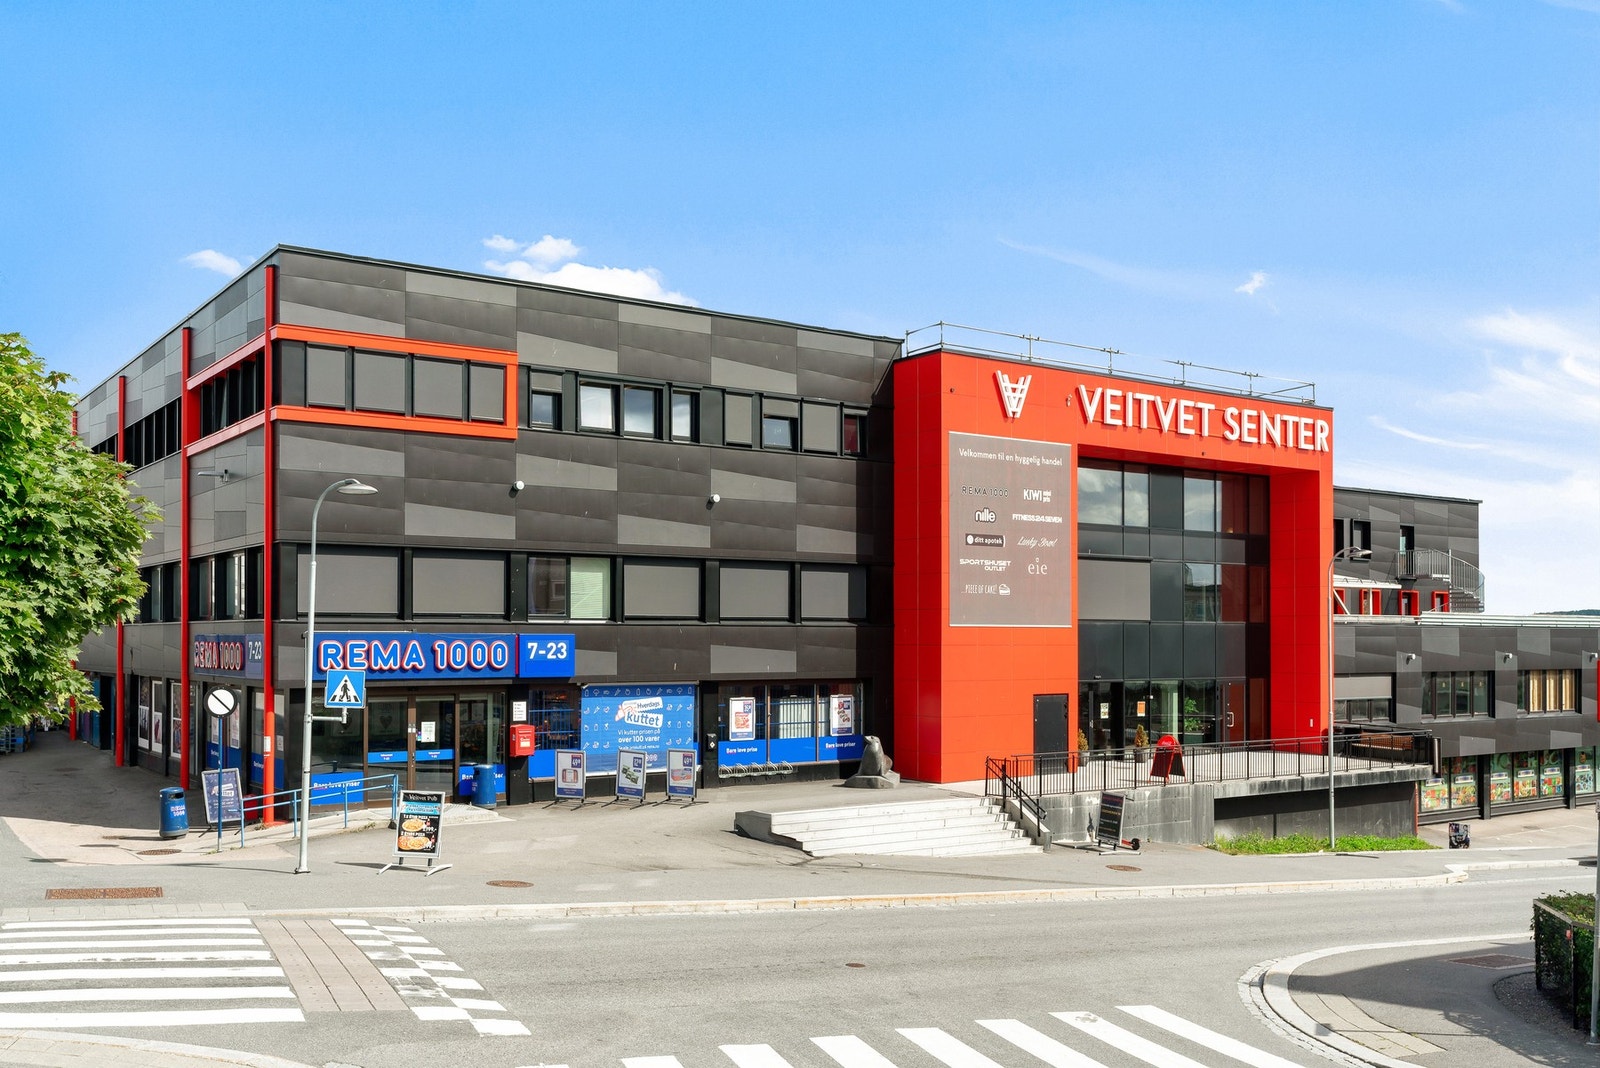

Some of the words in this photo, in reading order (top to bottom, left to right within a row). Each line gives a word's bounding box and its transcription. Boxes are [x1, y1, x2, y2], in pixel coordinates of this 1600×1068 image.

[1078, 384, 1215, 438] VEITVET
[1223, 406, 1330, 453] SENTER
[959, 448, 997, 460] Velkommen
[1015, 456, 1041, 466] hyggelig
[1042, 457, 1063, 466] handel
[962, 486, 988, 496] REMA
[989, 489, 1009, 497] 1000
[1023, 488, 1043, 501] KIWI
[975, 507, 997, 523] nille
[985, 537, 1003, 546] apotek
[960, 558, 1012, 567] SPORTSHUSET
[1028, 557, 1048, 575] eie
[194, 641, 219, 669] REMA
[220, 641, 243, 671] 1000
[248, 641, 263, 660] 7-23
[318, 640, 427, 671] REMA
[433, 640, 510, 671] 1000
[527, 642, 568, 660] 7-23
[626, 711, 660, 727] kuttet
[633, 735, 644, 743] 100
